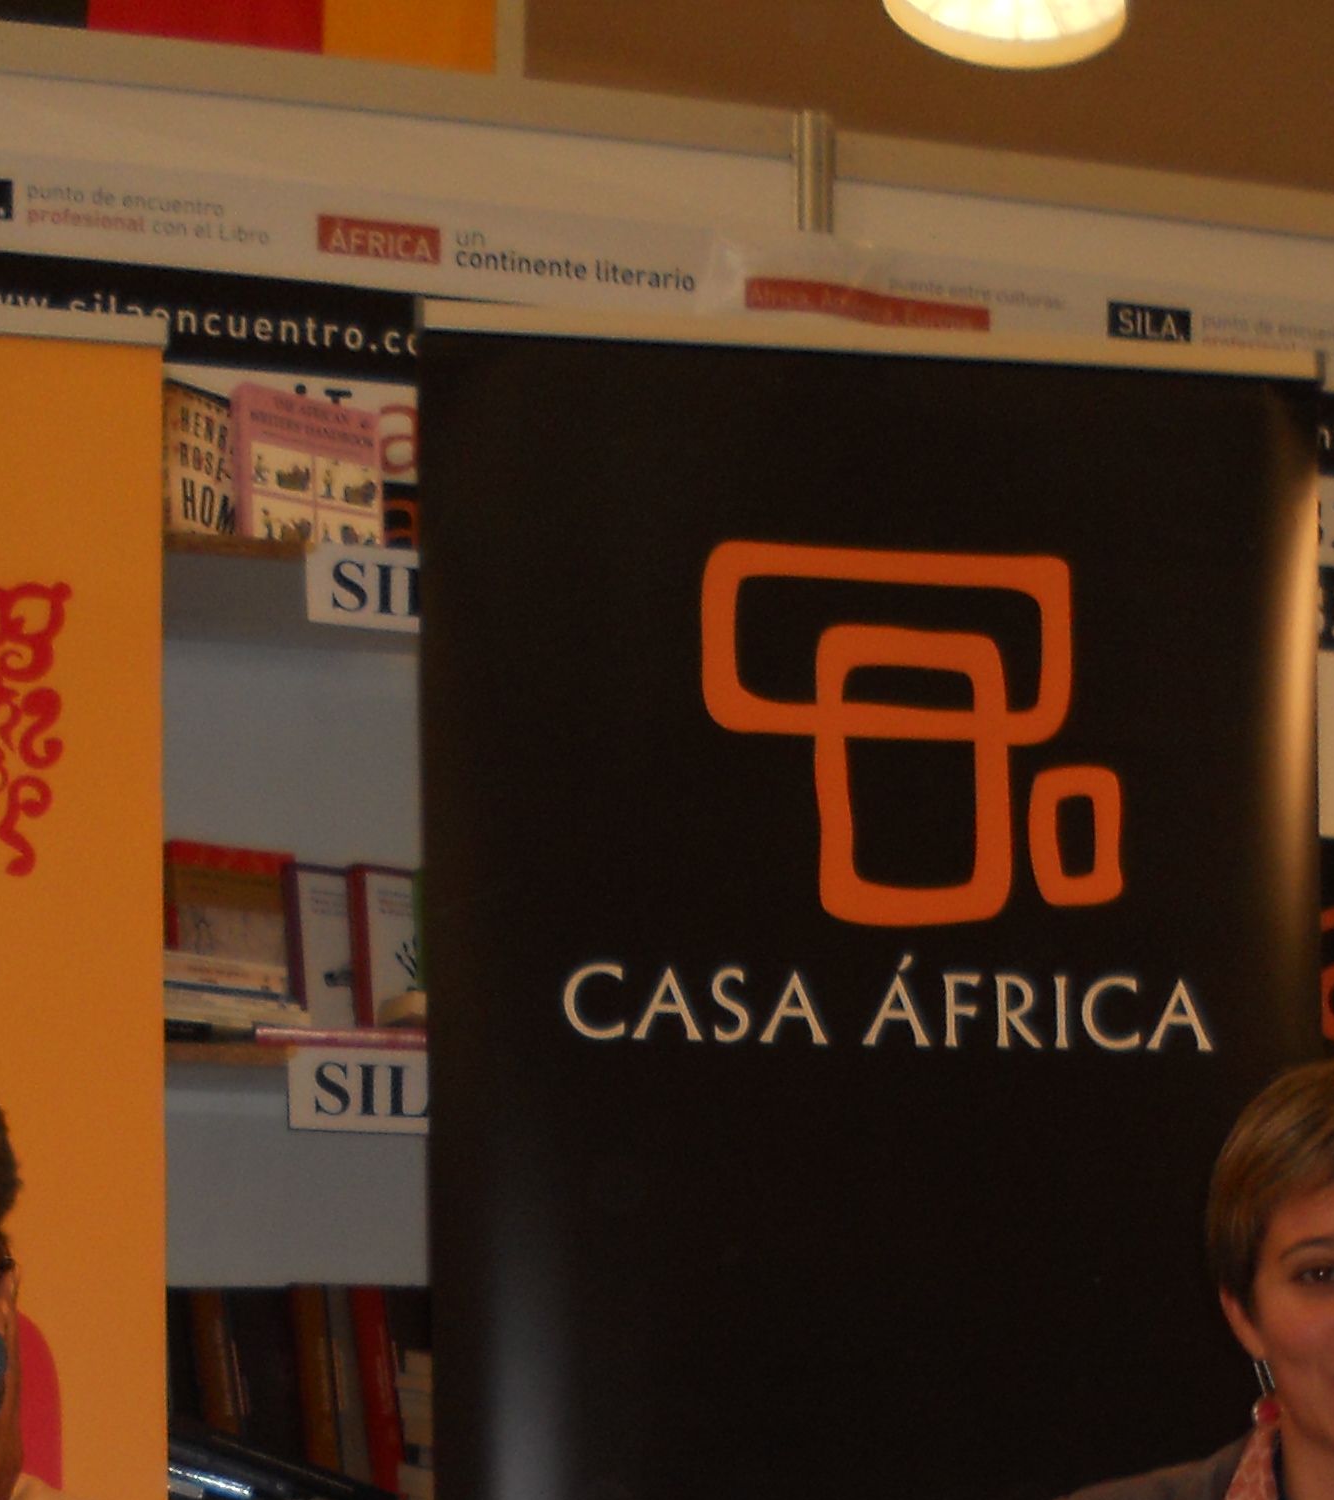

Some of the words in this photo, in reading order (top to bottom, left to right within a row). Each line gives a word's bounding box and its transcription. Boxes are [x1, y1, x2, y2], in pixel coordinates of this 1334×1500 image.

[92, 187, 113, 207] de
[329, 224, 433, 263] ÁFRICA
[455, 231, 486, 248] un
[455, 250, 587, 281] continente
[595, 259, 696, 292] literario
[563, 962, 829, 1046] CASA
[862, 953, 1215, 1053] ÁFRICA
